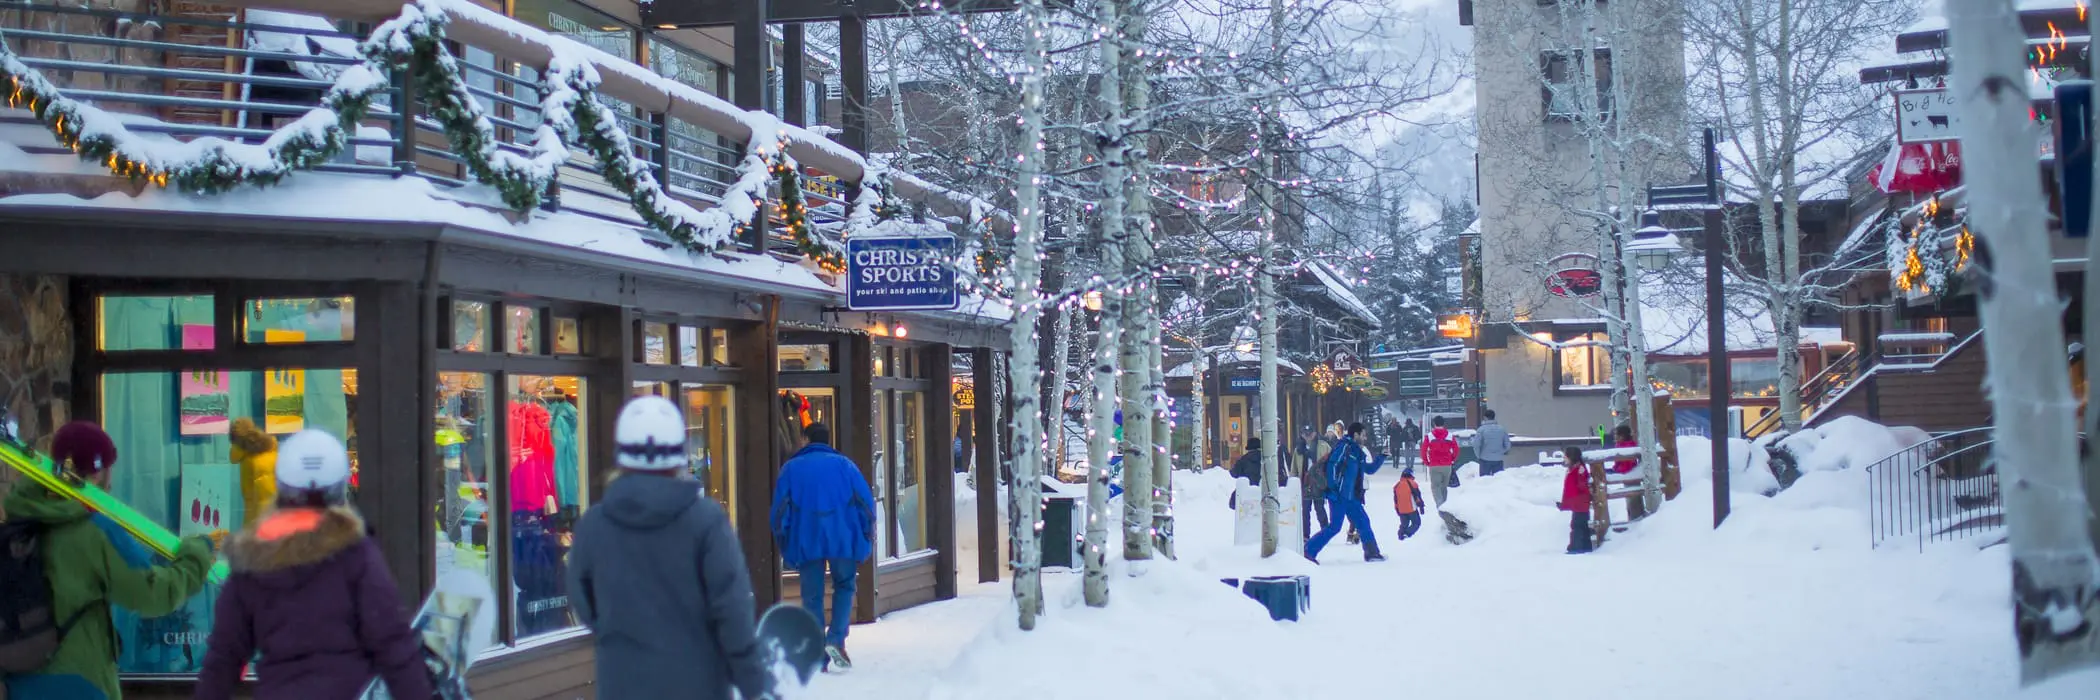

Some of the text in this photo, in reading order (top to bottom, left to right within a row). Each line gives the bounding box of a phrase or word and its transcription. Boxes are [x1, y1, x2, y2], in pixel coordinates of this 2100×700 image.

[548, 12, 577, 35] CHRISTY
[862, 266, 941, 284] SPORTS
[856, 286, 948, 296] your ski and patio shop
